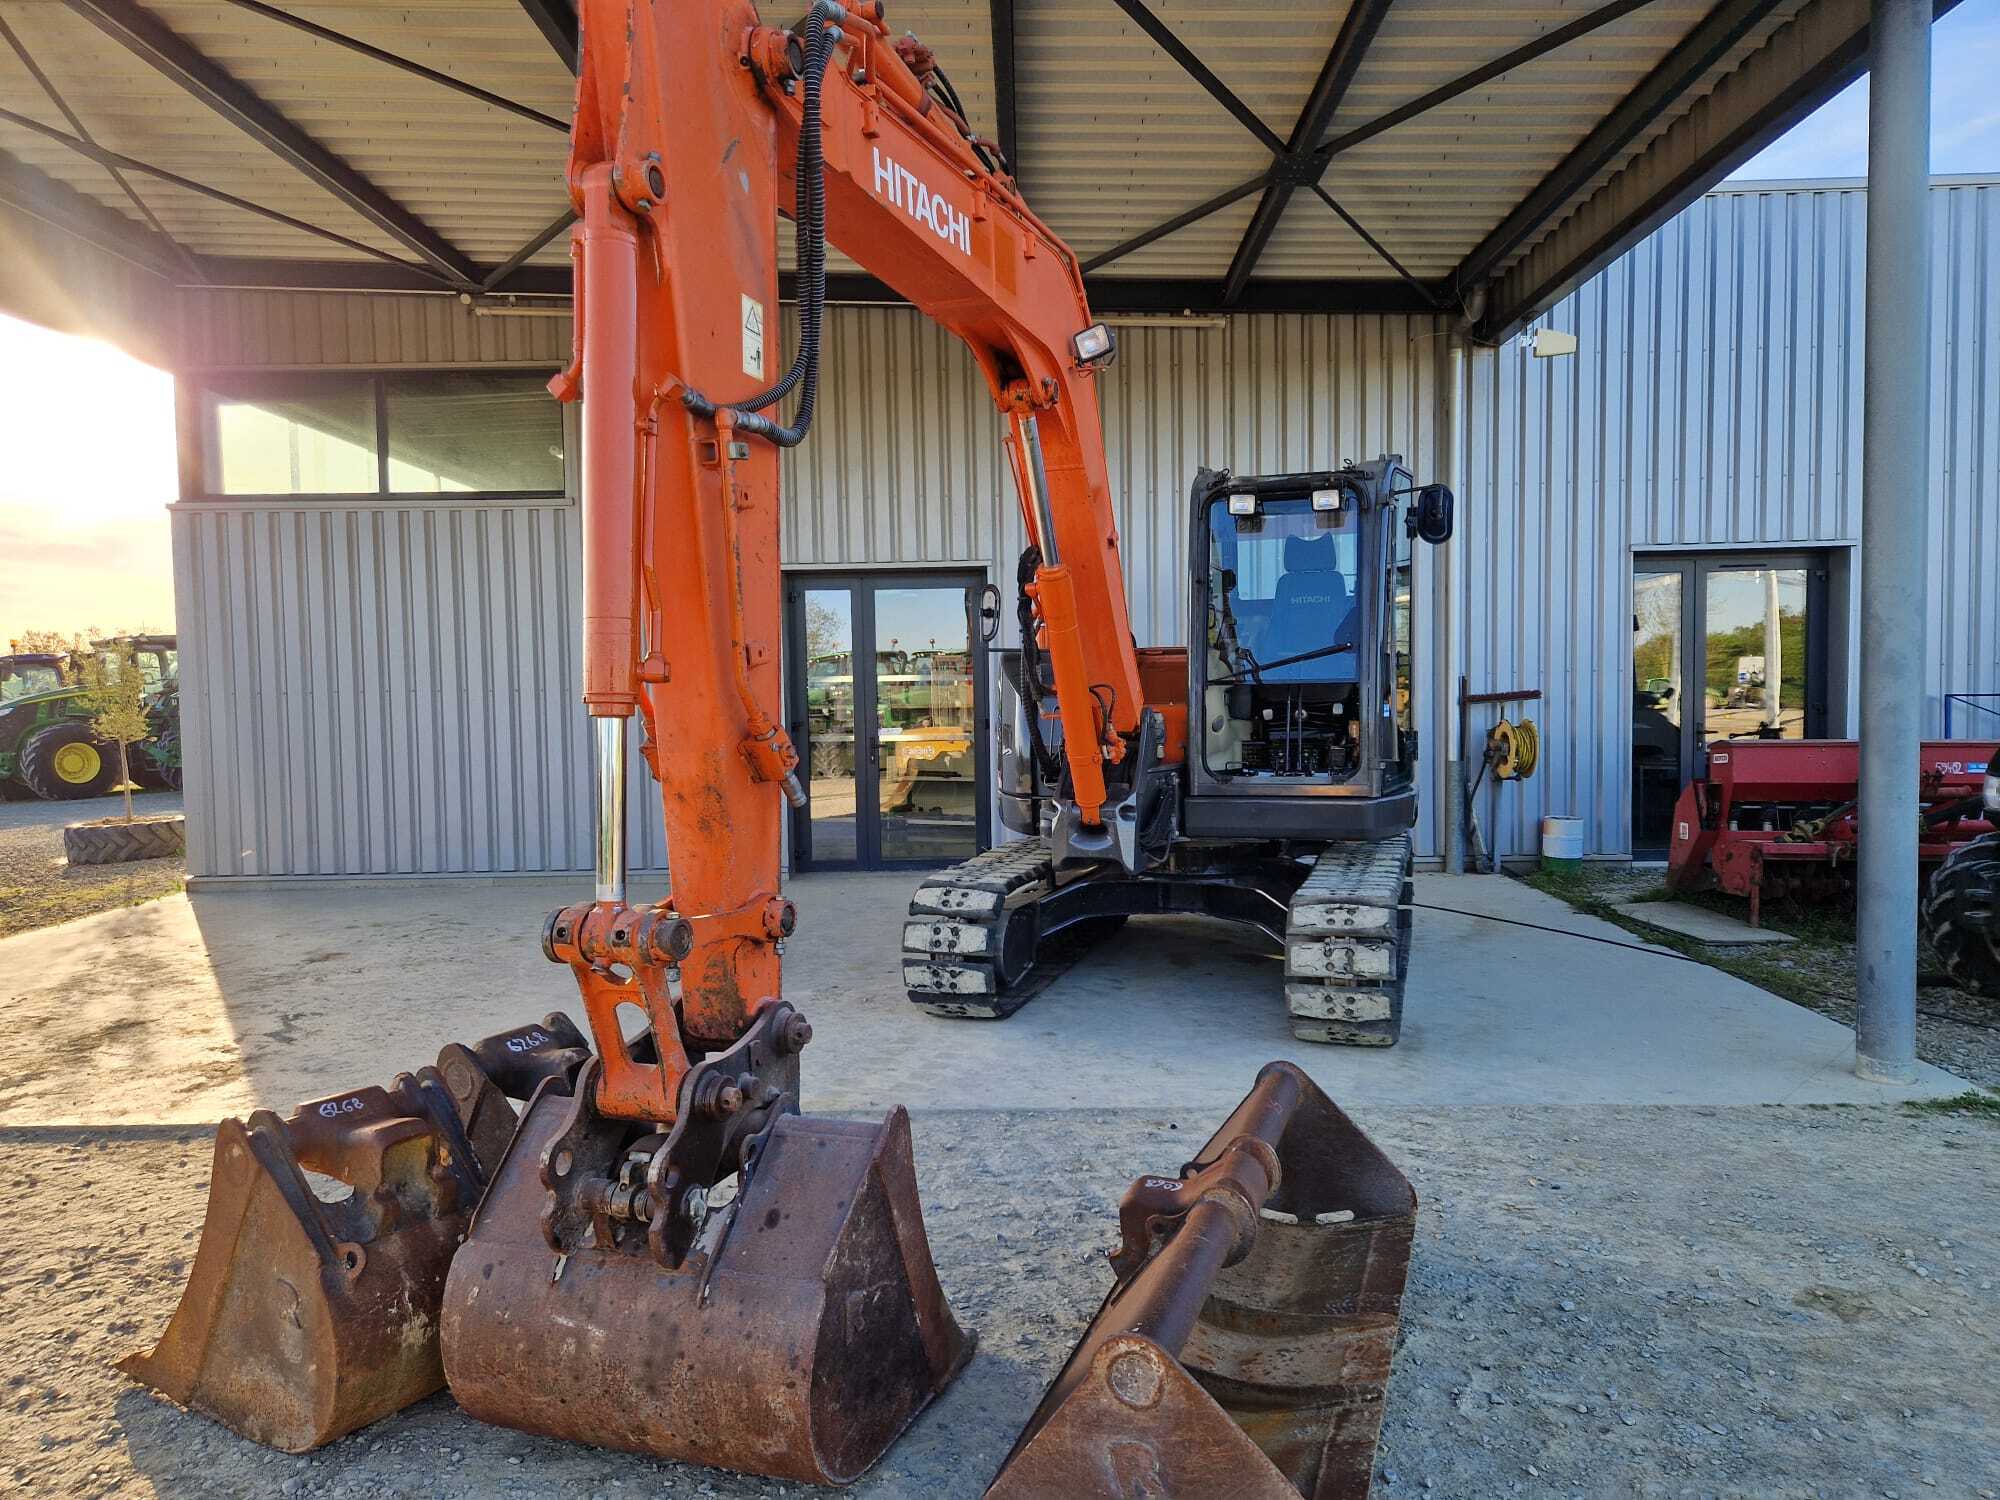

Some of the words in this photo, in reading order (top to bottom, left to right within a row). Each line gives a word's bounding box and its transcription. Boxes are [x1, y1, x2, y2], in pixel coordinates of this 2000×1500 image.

[873, 146, 972, 256] HITACHI
[1290, 595, 1331, 604] HITACHI
[506, 1031, 549, 1052] 6268
